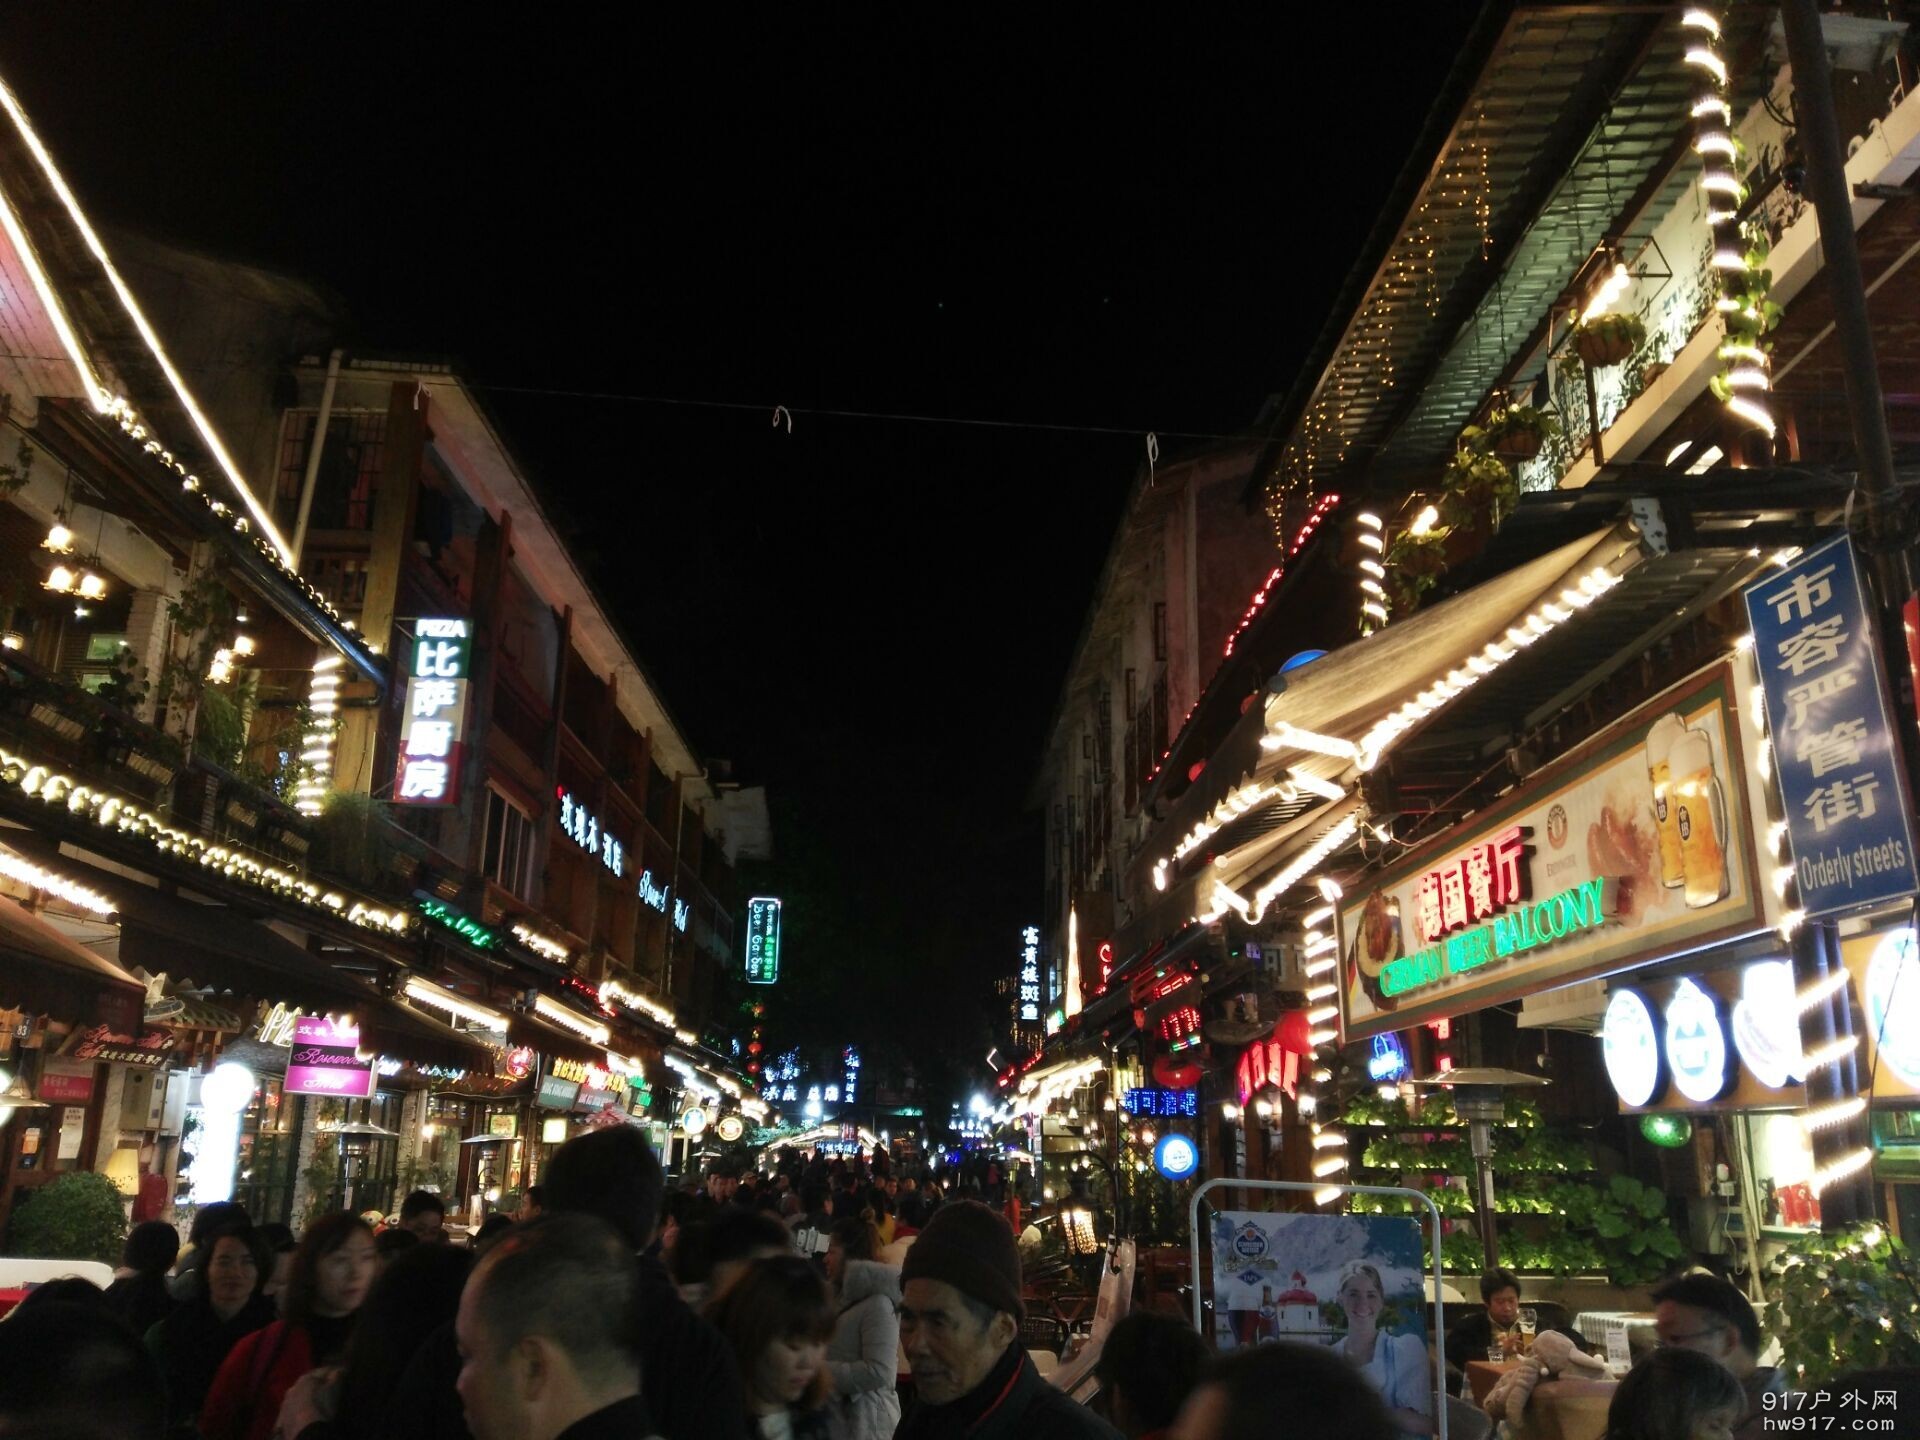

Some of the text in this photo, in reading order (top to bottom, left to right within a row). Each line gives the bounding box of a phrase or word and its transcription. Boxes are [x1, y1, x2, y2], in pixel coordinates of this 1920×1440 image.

[416, 619, 467, 638] PIZZA
[400, 641, 461, 798] 比萨厨房
[1767, 563, 1880, 833] 市容严管街
[1418, 826, 1524, 942] 德国餐厅
[1802, 836, 1906, 890] Orderly streets
[1380, 875, 1604, 997] GERMAN BEER BALCONY
[16, 1025, 28, 1036] 83
